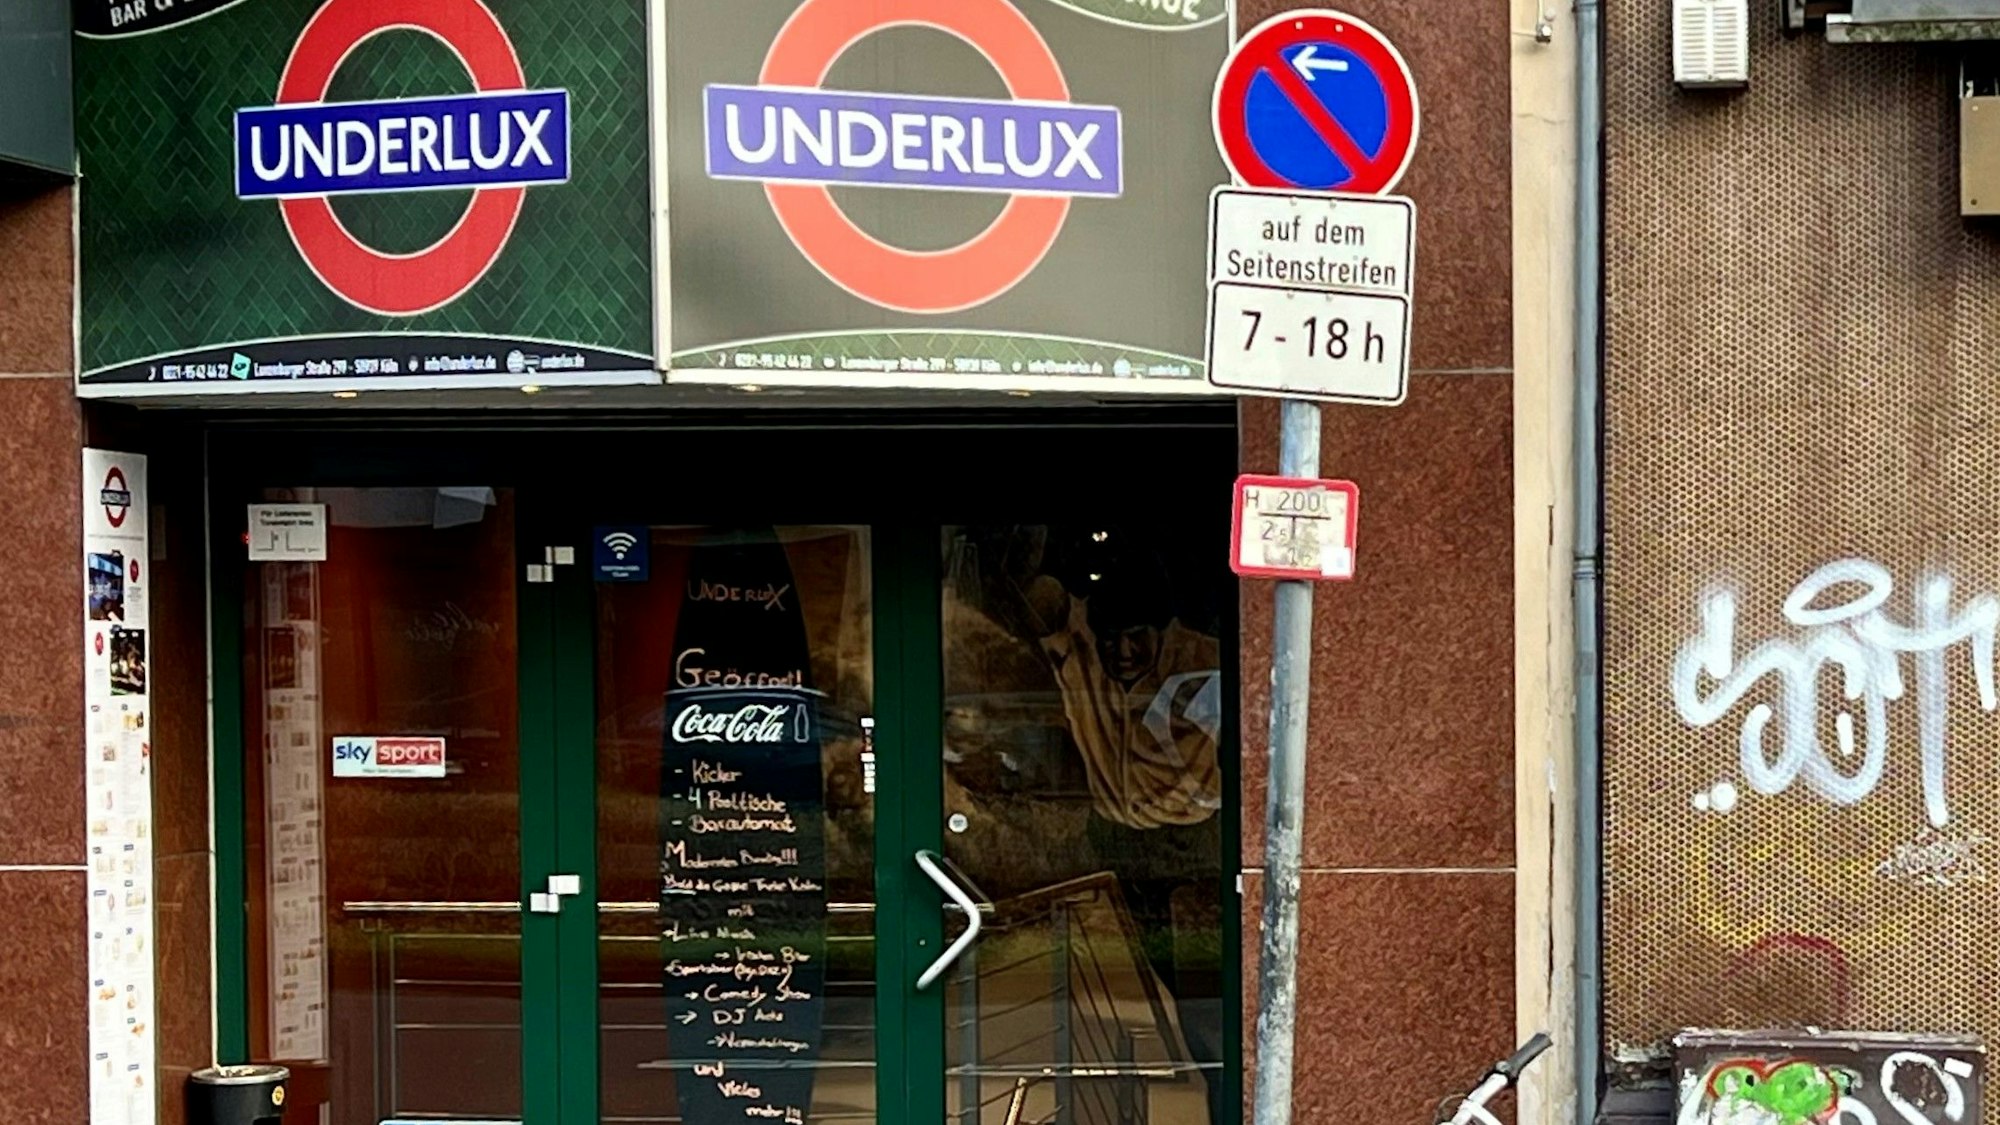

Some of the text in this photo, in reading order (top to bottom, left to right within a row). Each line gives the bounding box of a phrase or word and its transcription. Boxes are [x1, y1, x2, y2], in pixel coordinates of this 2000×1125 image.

[251, 109, 553, 181] UNDERLUX
[725, 104, 1102, 179] UNDERLUX
[1262, 215, 1364, 246] auf dem
[1227, 249, 1396, 286] Seitenstreifen
[1241, 310, 1261, 351] 7
[1303, 317, 1348, 360] 18
[1364, 321, 1384, 363] h
[1246, 489, 1320, 512] H 200
[672, 704, 789, 743] Coca-Cola
[335, 741, 439, 764] sky sport
[692, 758, 743, 784] Kicker
[688, 786, 701, 810] 4
[708, 790, 787, 813] Pooltische
[704, 984, 767, 1007] Comedy
[712, 1008, 746, 1024] DJ
[693, 1061, 724, 1077] und
